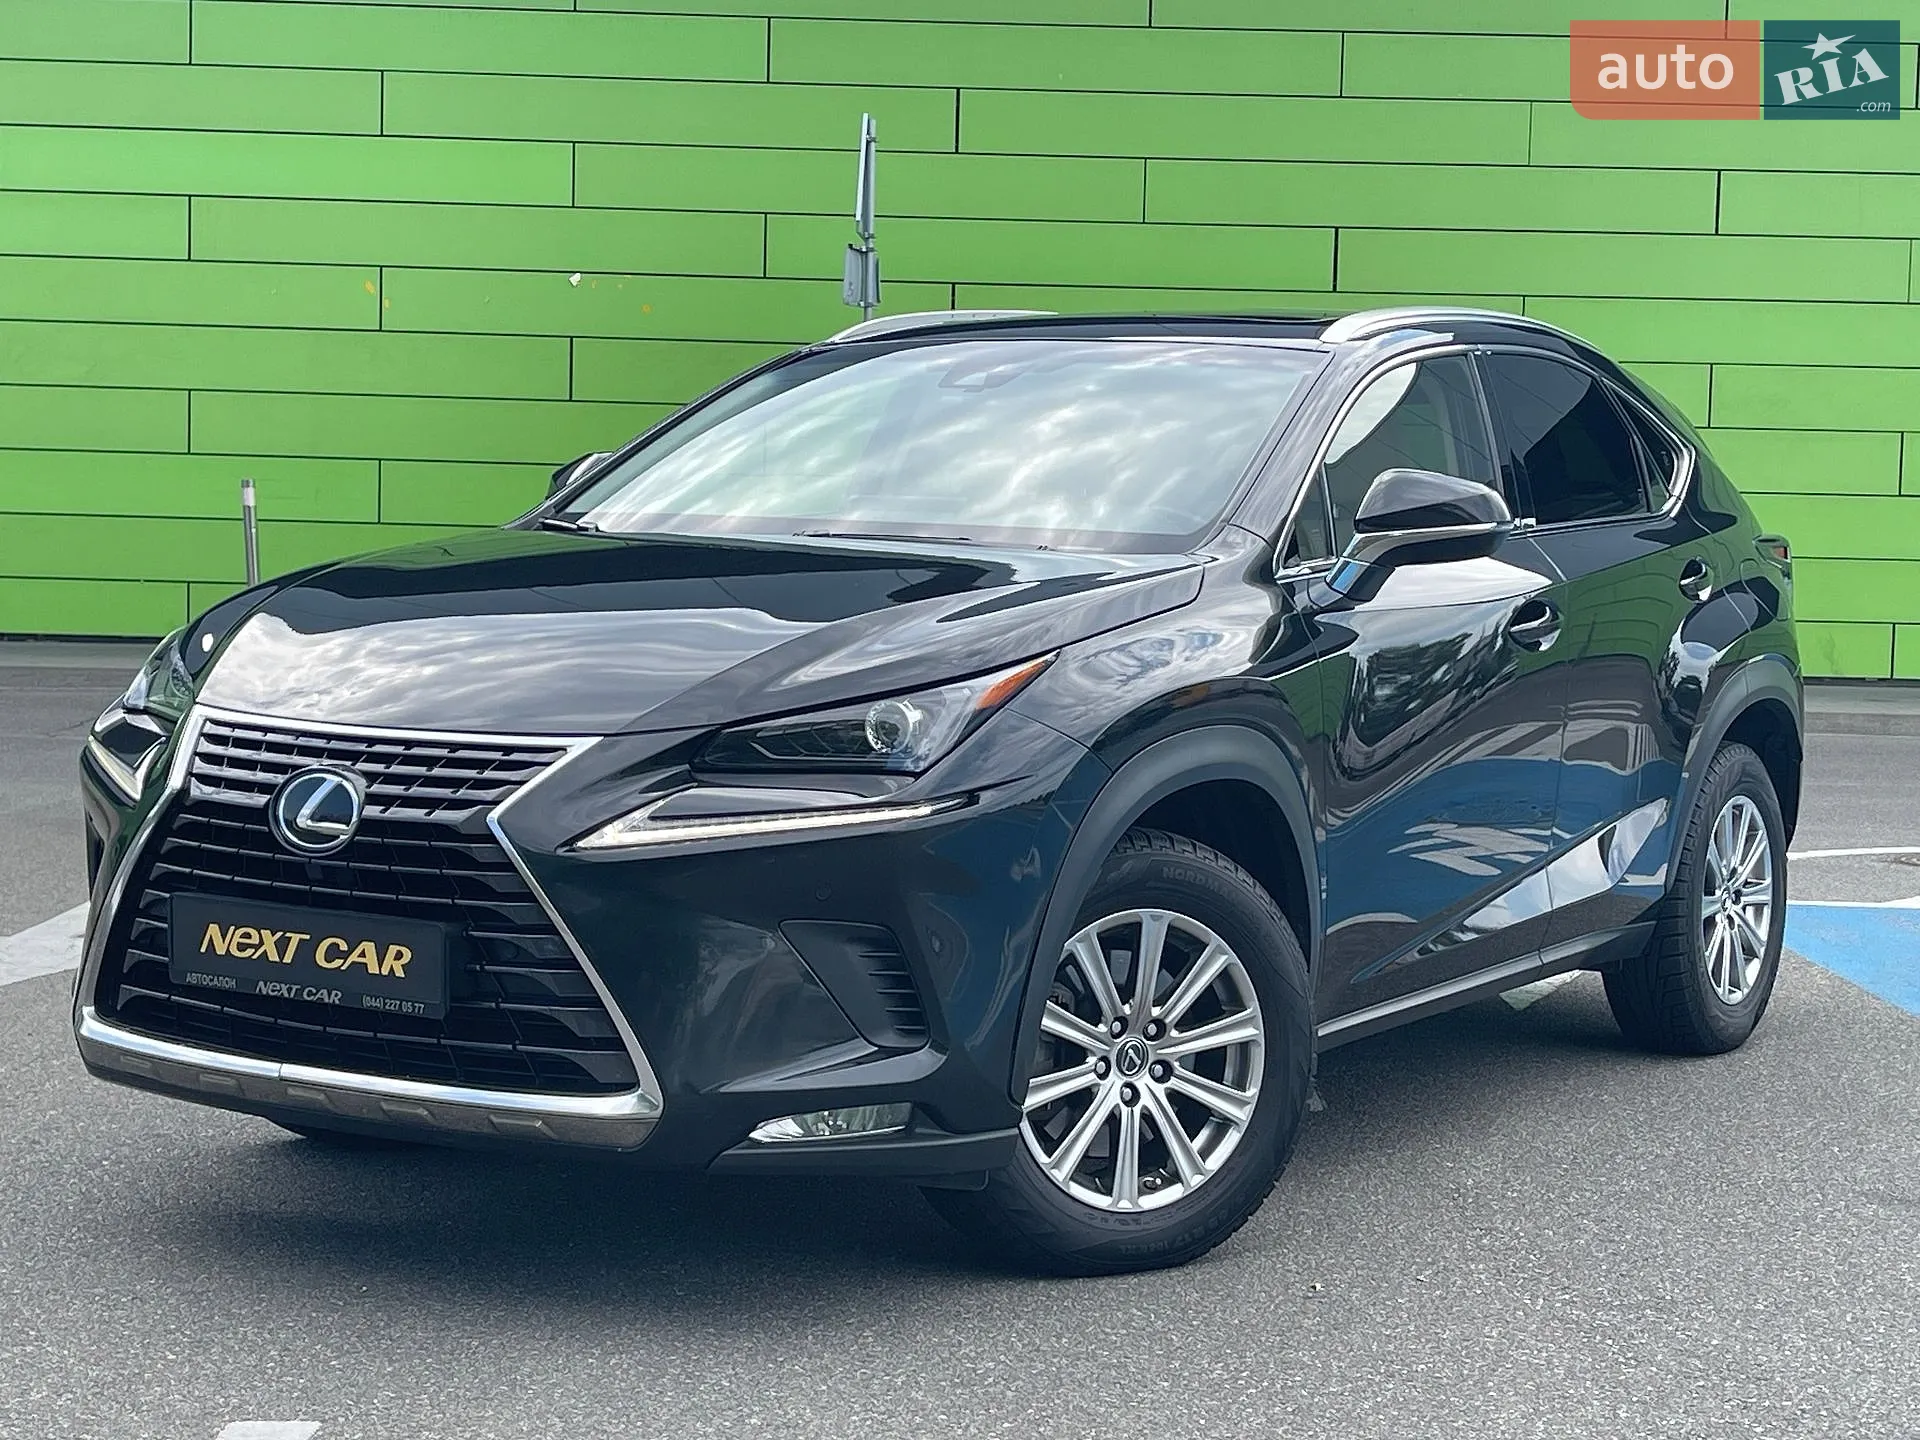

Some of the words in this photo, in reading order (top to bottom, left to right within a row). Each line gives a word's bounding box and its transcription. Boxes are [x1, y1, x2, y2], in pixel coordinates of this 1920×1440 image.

[315, 936, 412, 978] CAR
[185, 971, 237, 989] АВТОСАЛОН
[302, 986, 343, 1005] CAR
[362, 994, 384, 1010] (044)
[384, 998, 401, 1011] 227
[401, 1001, 413, 1013] 05
[413, 1003, 425, 1015] 77
